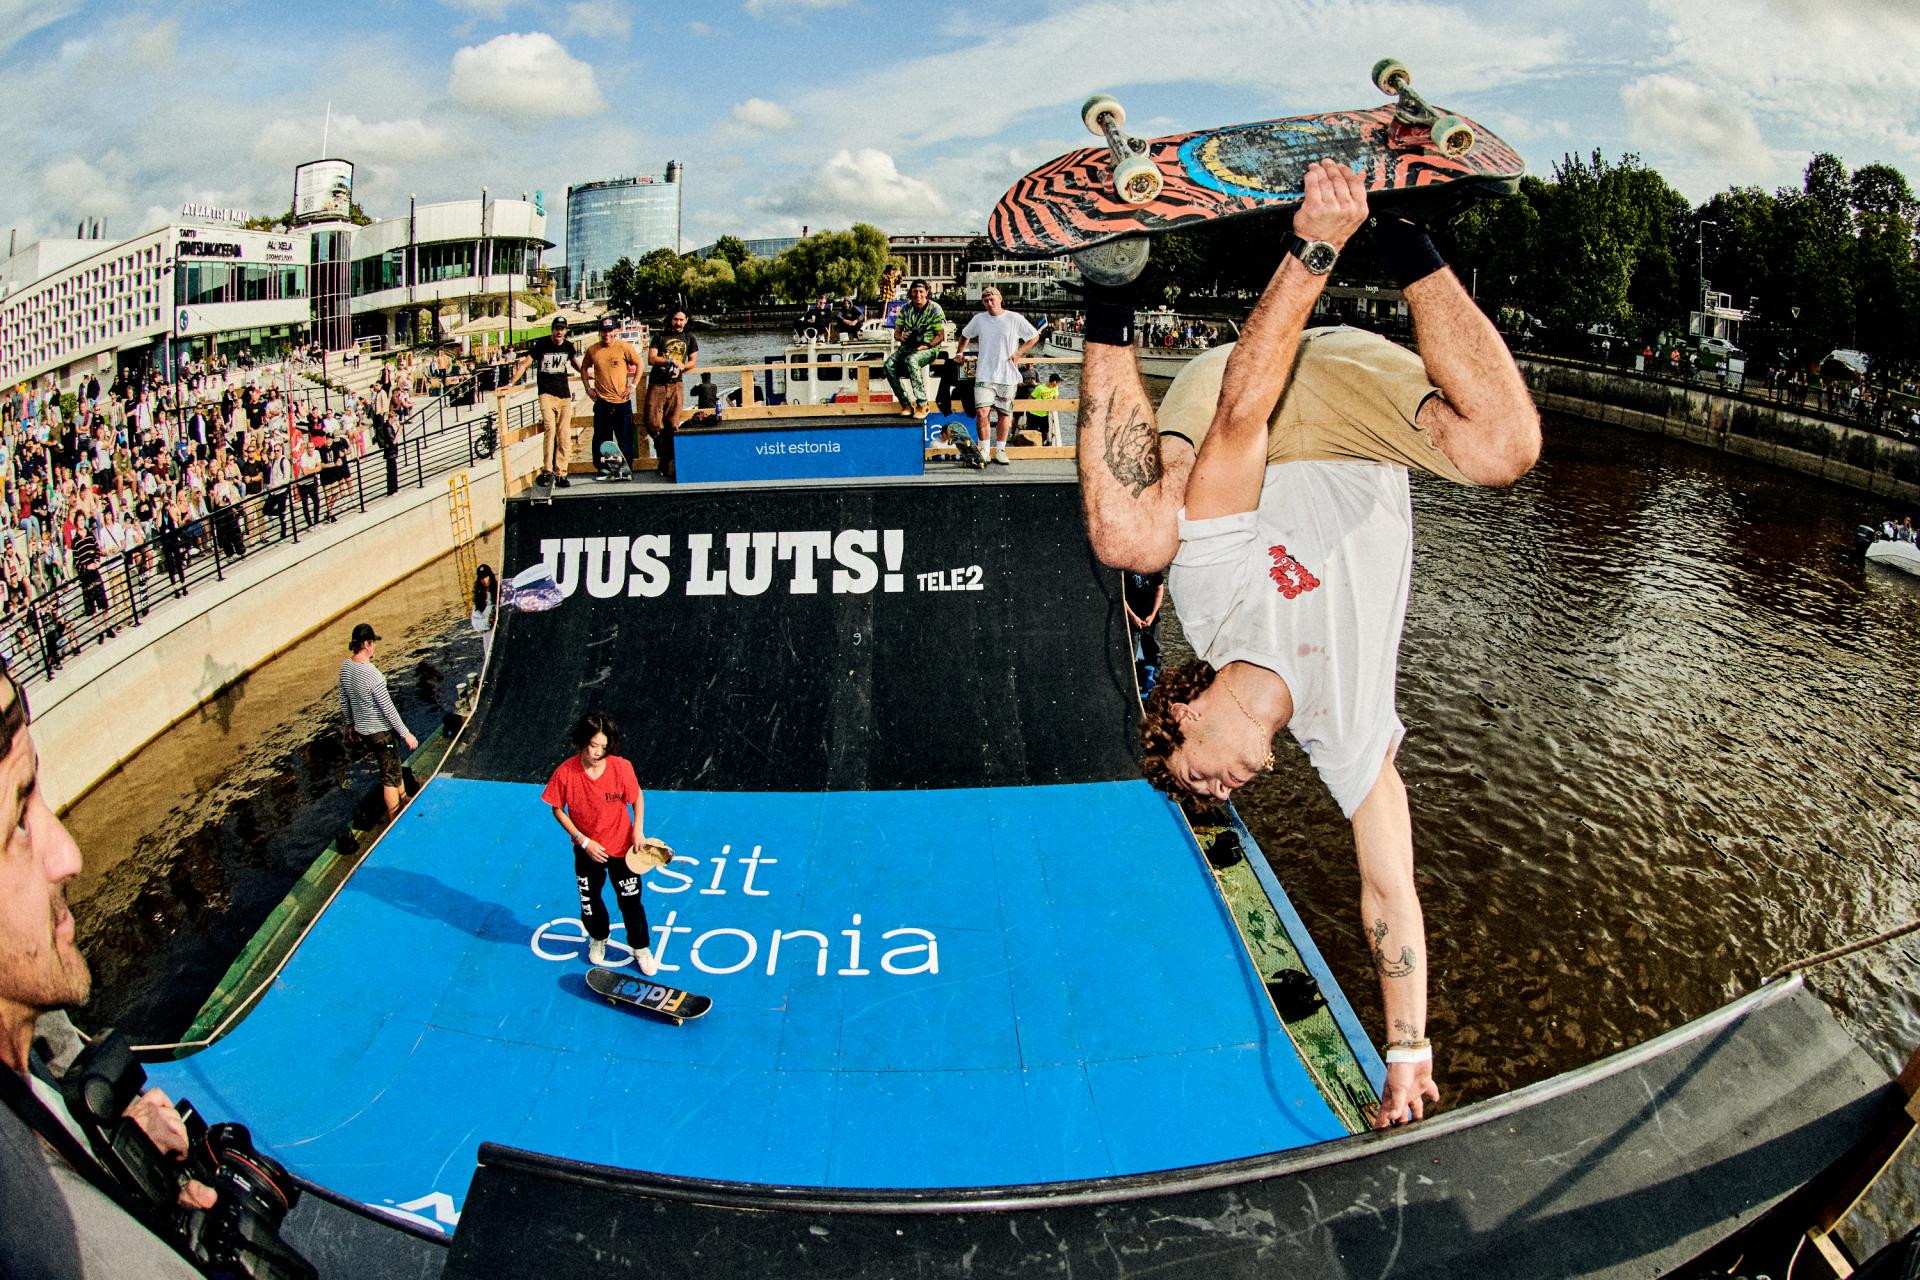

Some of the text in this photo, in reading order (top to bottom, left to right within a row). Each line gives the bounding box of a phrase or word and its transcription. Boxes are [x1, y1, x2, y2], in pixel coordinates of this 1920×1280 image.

[755, 440, 841, 455] visit estonia
[540, 529, 905, 599] UUS LUTS!
[916, 565, 984, 592] TELE2
[647, 844, 778, 896] sit
[530, 910, 939, 976] estonia
